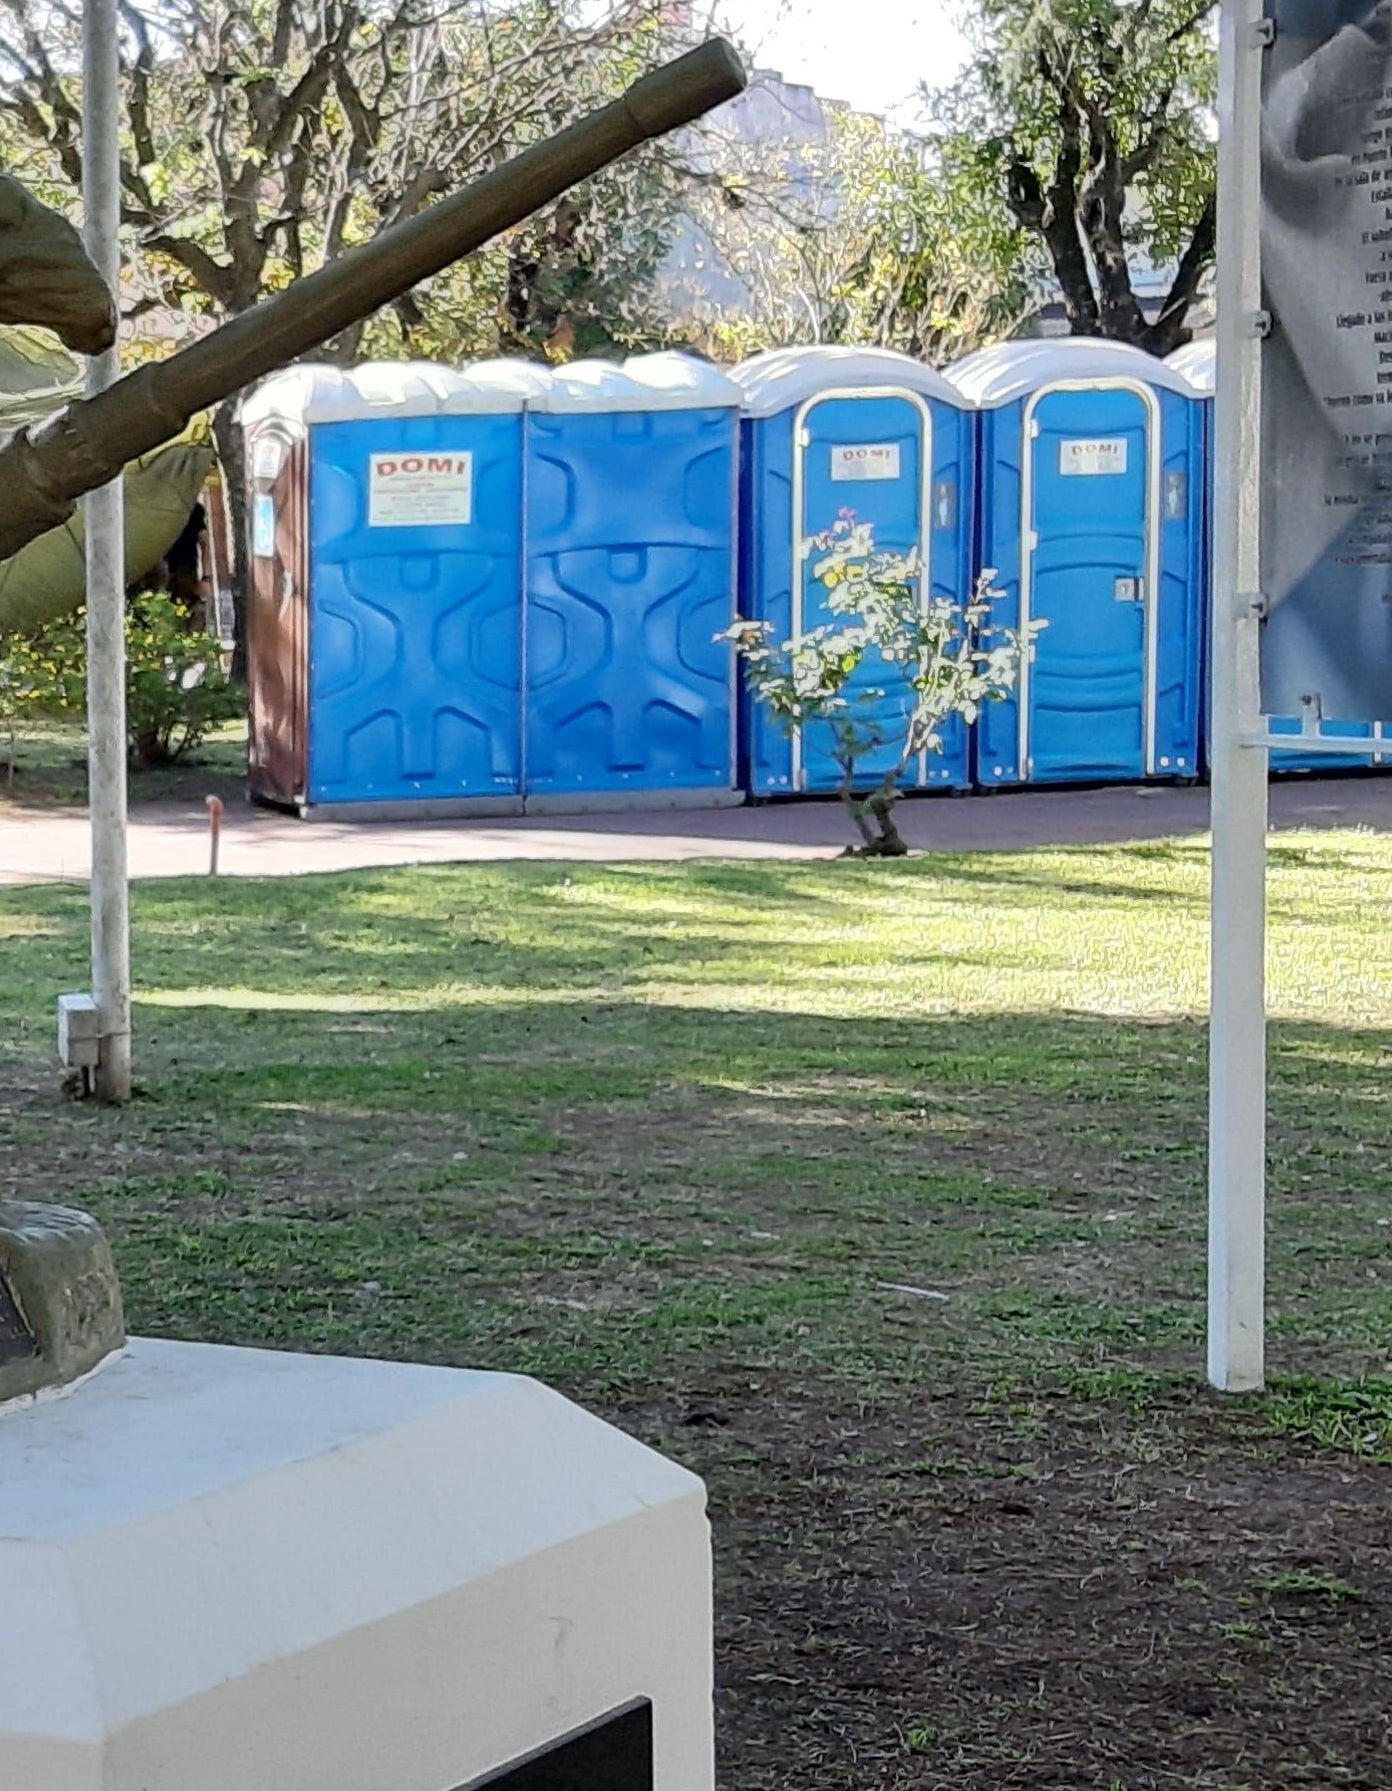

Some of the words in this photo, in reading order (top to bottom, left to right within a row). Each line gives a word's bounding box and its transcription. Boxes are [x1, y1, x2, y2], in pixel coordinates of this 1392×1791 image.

[843, 449, 890, 462] DOMI
[1072, 443, 1118, 456] DOMI
[376, 457, 466, 477] DOMI
